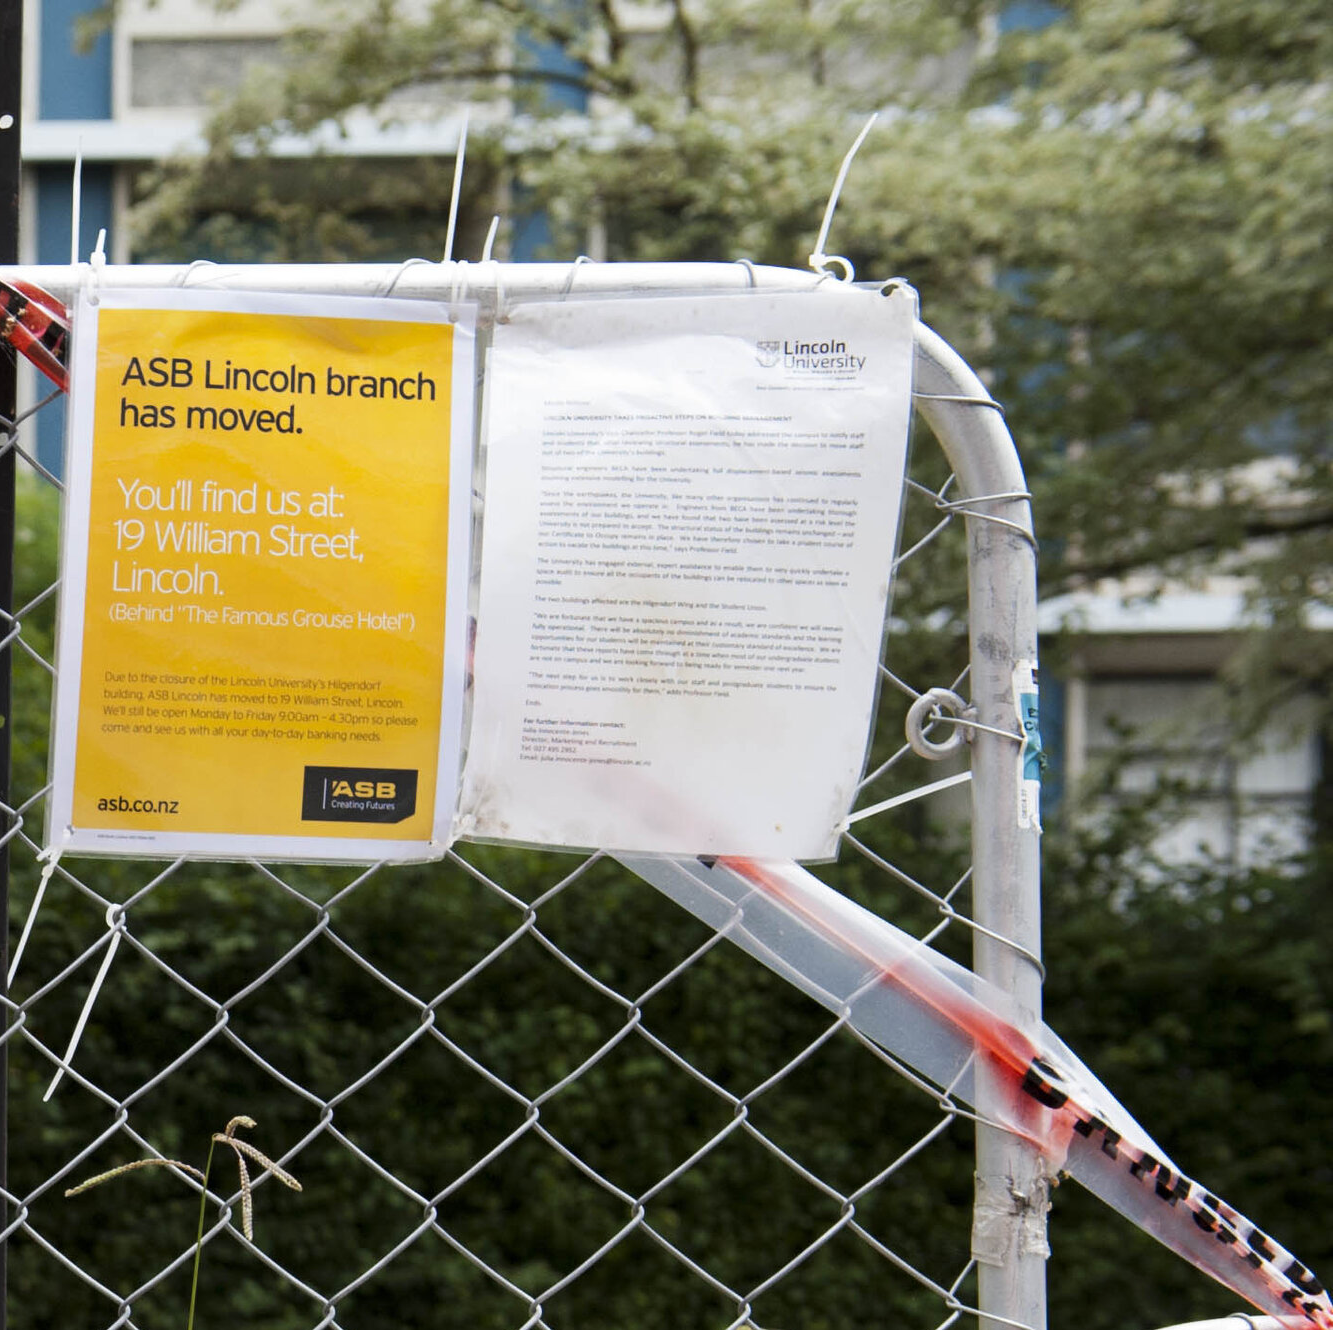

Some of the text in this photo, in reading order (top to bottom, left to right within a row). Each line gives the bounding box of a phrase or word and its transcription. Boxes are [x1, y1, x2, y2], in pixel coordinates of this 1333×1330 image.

[784, 339, 846, 355] Lincoln
[784, 354, 866, 370] University
[122, 357, 435, 401] ASB Lincoln branch
[120, 397, 303, 434] has moved.
[117, 478, 345, 518] You'll find us at:
[113, 519, 364, 563] 19 William Street,
[112, 560, 224, 596] Lincoln.
[222, 606, 289, 626] Famous
[292, 608, 354, 630] Grouse
[105, 671, 381, 691] Due to the closure of the Lincoln University's Hilgendorf
[147, 689, 169, 701] ASB
[171, 691, 207, 702] Lincoln
[209, 692, 228, 703] has
[230, 693, 265, 704] moved
[267, 693, 278, 704] to
[280, 694, 291, 705] 19
[294, 695, 329, 706] William
[103, 705, 126, 716] We'll
[128, 706, 144, 716] still
[146, 706, 160, 717] be
[161, 708, 187, 719] open
[190, 708, 231, 721] Monday
[233, 710, 244, 720] to
[246, 709, 277, 723] Friday
[371, 716, 384, 725] so
[385, 715, 418, 727] please
[101, 724, 131, 733] come
[132, 724, 152, 734] and
[154, 725, 172, 735] see
[174, 726, 187, 735] us
[188, 725, 210, 736] with
[212, 726, 224, 736] all
[226, 728, 249, 737] your
[251, 727, 306, 741] day-to-day
[307, 729, 347, 743] banking
[332, 780, 396, 799] ASB
[98, 795, 179, 814] asb.co.nz
[331, 799, 395, 810] Creating Futures
